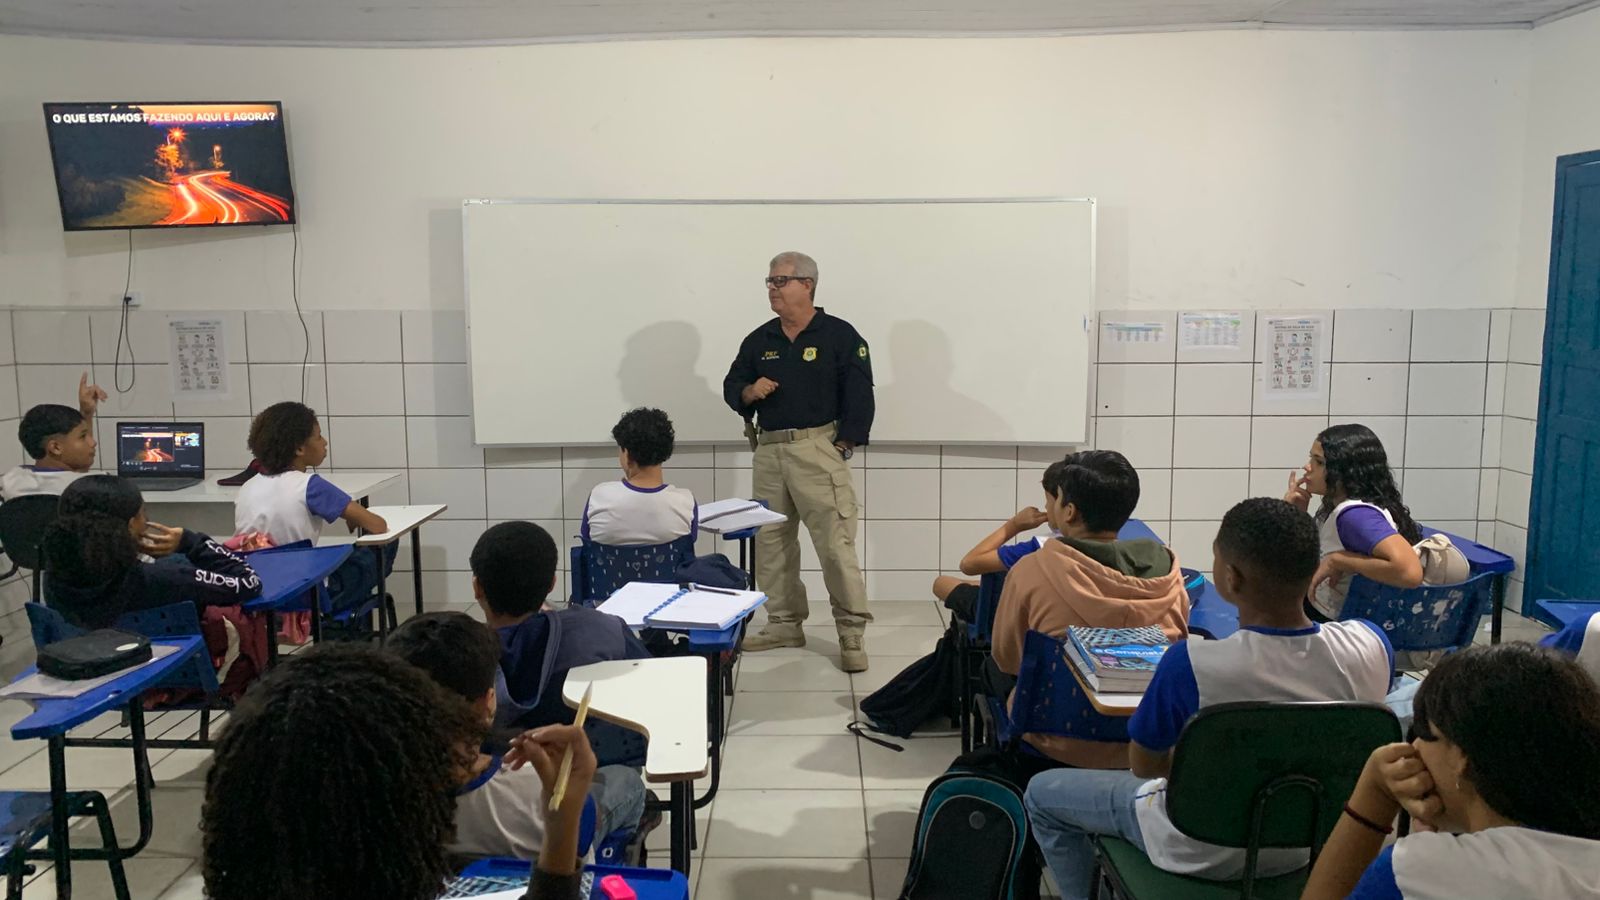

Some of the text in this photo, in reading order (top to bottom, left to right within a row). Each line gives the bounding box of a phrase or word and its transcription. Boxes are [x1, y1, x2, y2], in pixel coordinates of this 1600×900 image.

[52, 111, 275, 124] O QUE ESTAMOS FAZENDO AQUI E AGORA?
